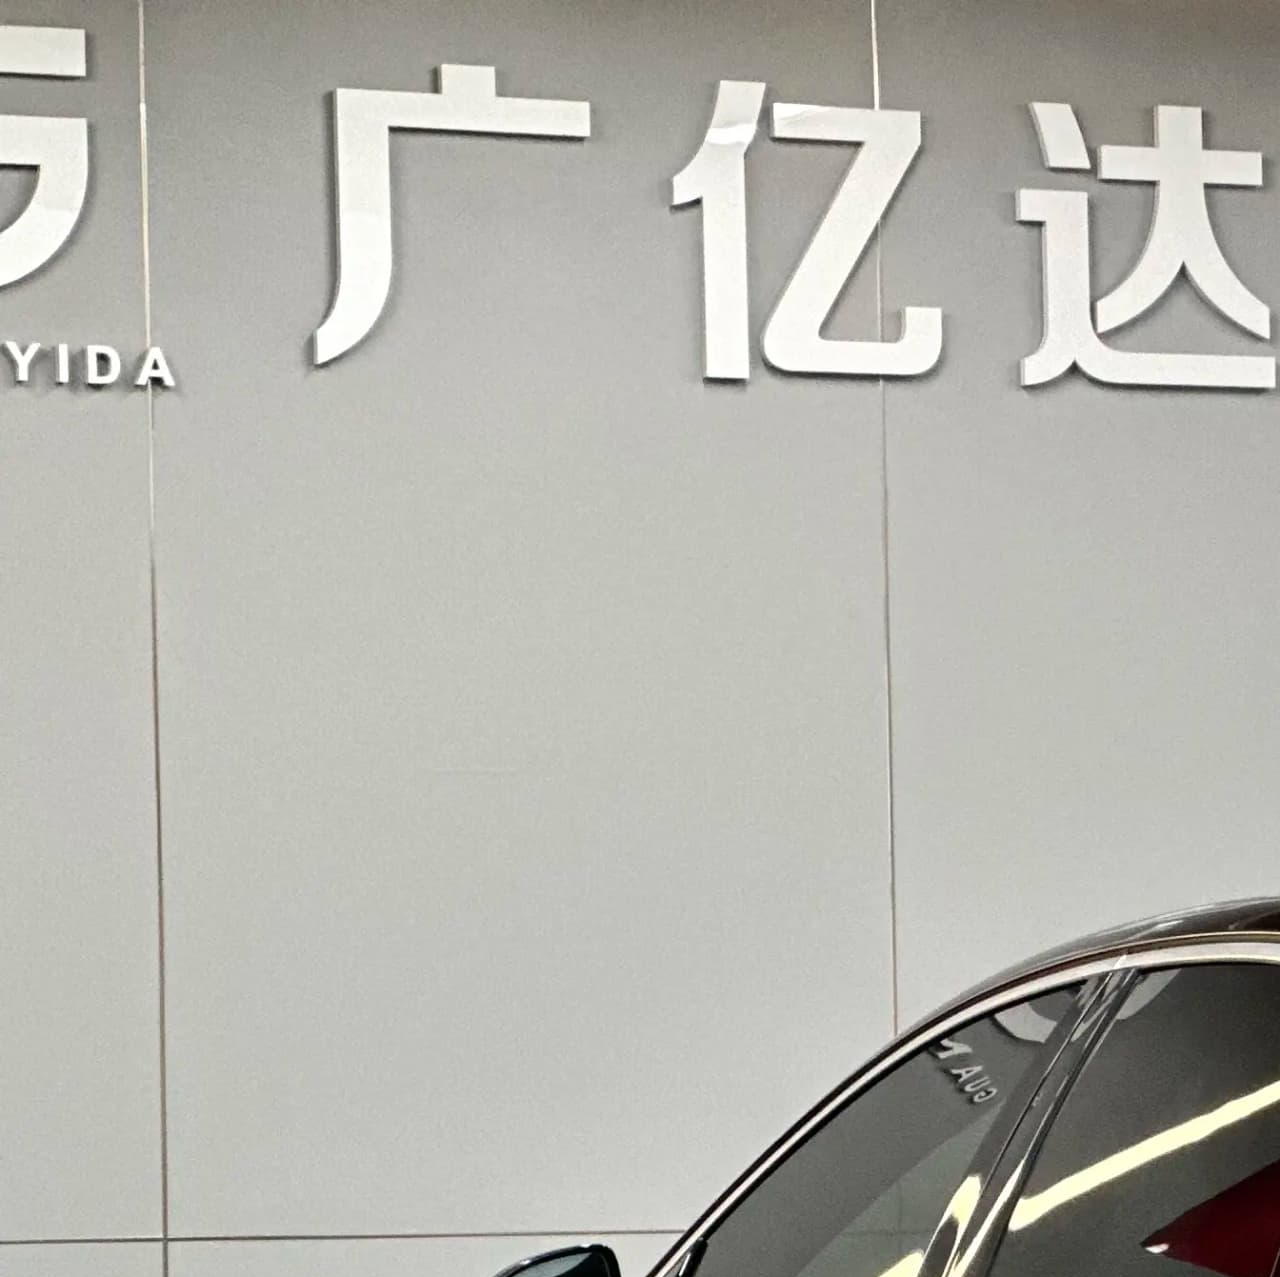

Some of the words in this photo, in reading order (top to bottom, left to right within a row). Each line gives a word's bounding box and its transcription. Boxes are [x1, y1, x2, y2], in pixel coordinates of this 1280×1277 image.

[313, 63, 1277, 389] 广亿达
[4, 340, 176, 387] YIDA
